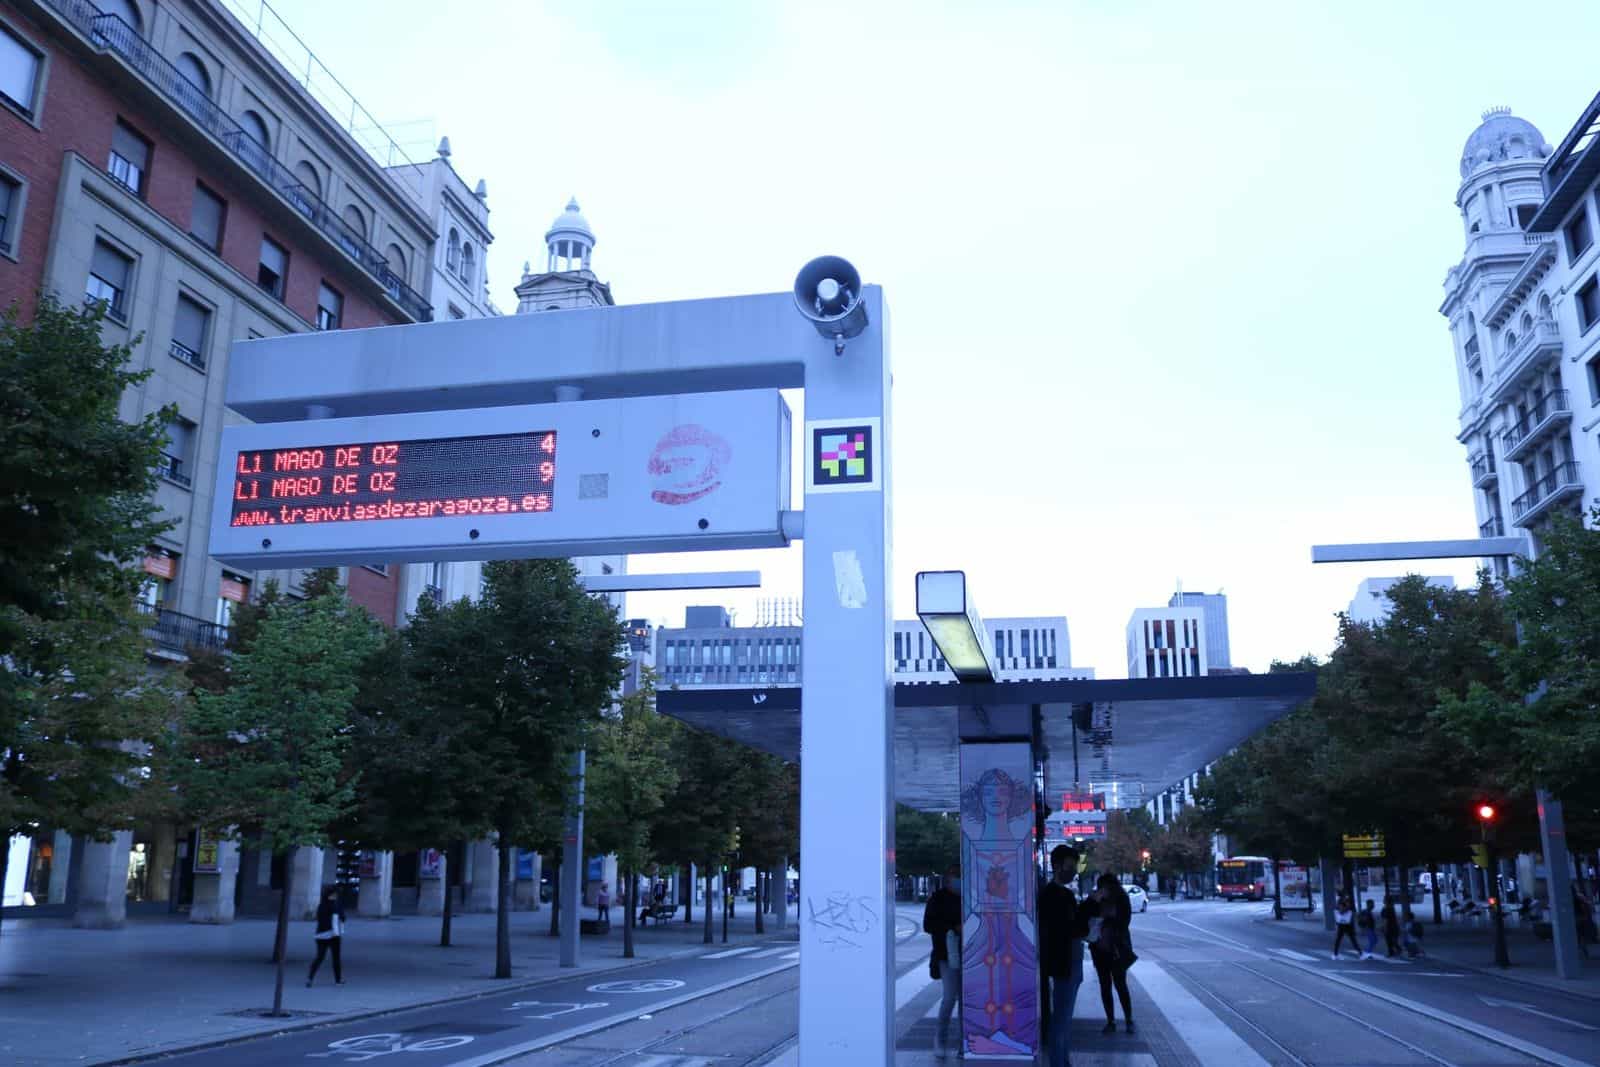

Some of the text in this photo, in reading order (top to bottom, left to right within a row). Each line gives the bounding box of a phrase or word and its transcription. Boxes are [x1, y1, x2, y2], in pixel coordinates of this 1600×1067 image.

[238, 434, 554, 474] L1 MAGO DE OZ 4
[236, 461, 554, 500] L1 MAGO DE OZ 9
[232, 494, 549, 526] www.tranviasdezaragoza.es
